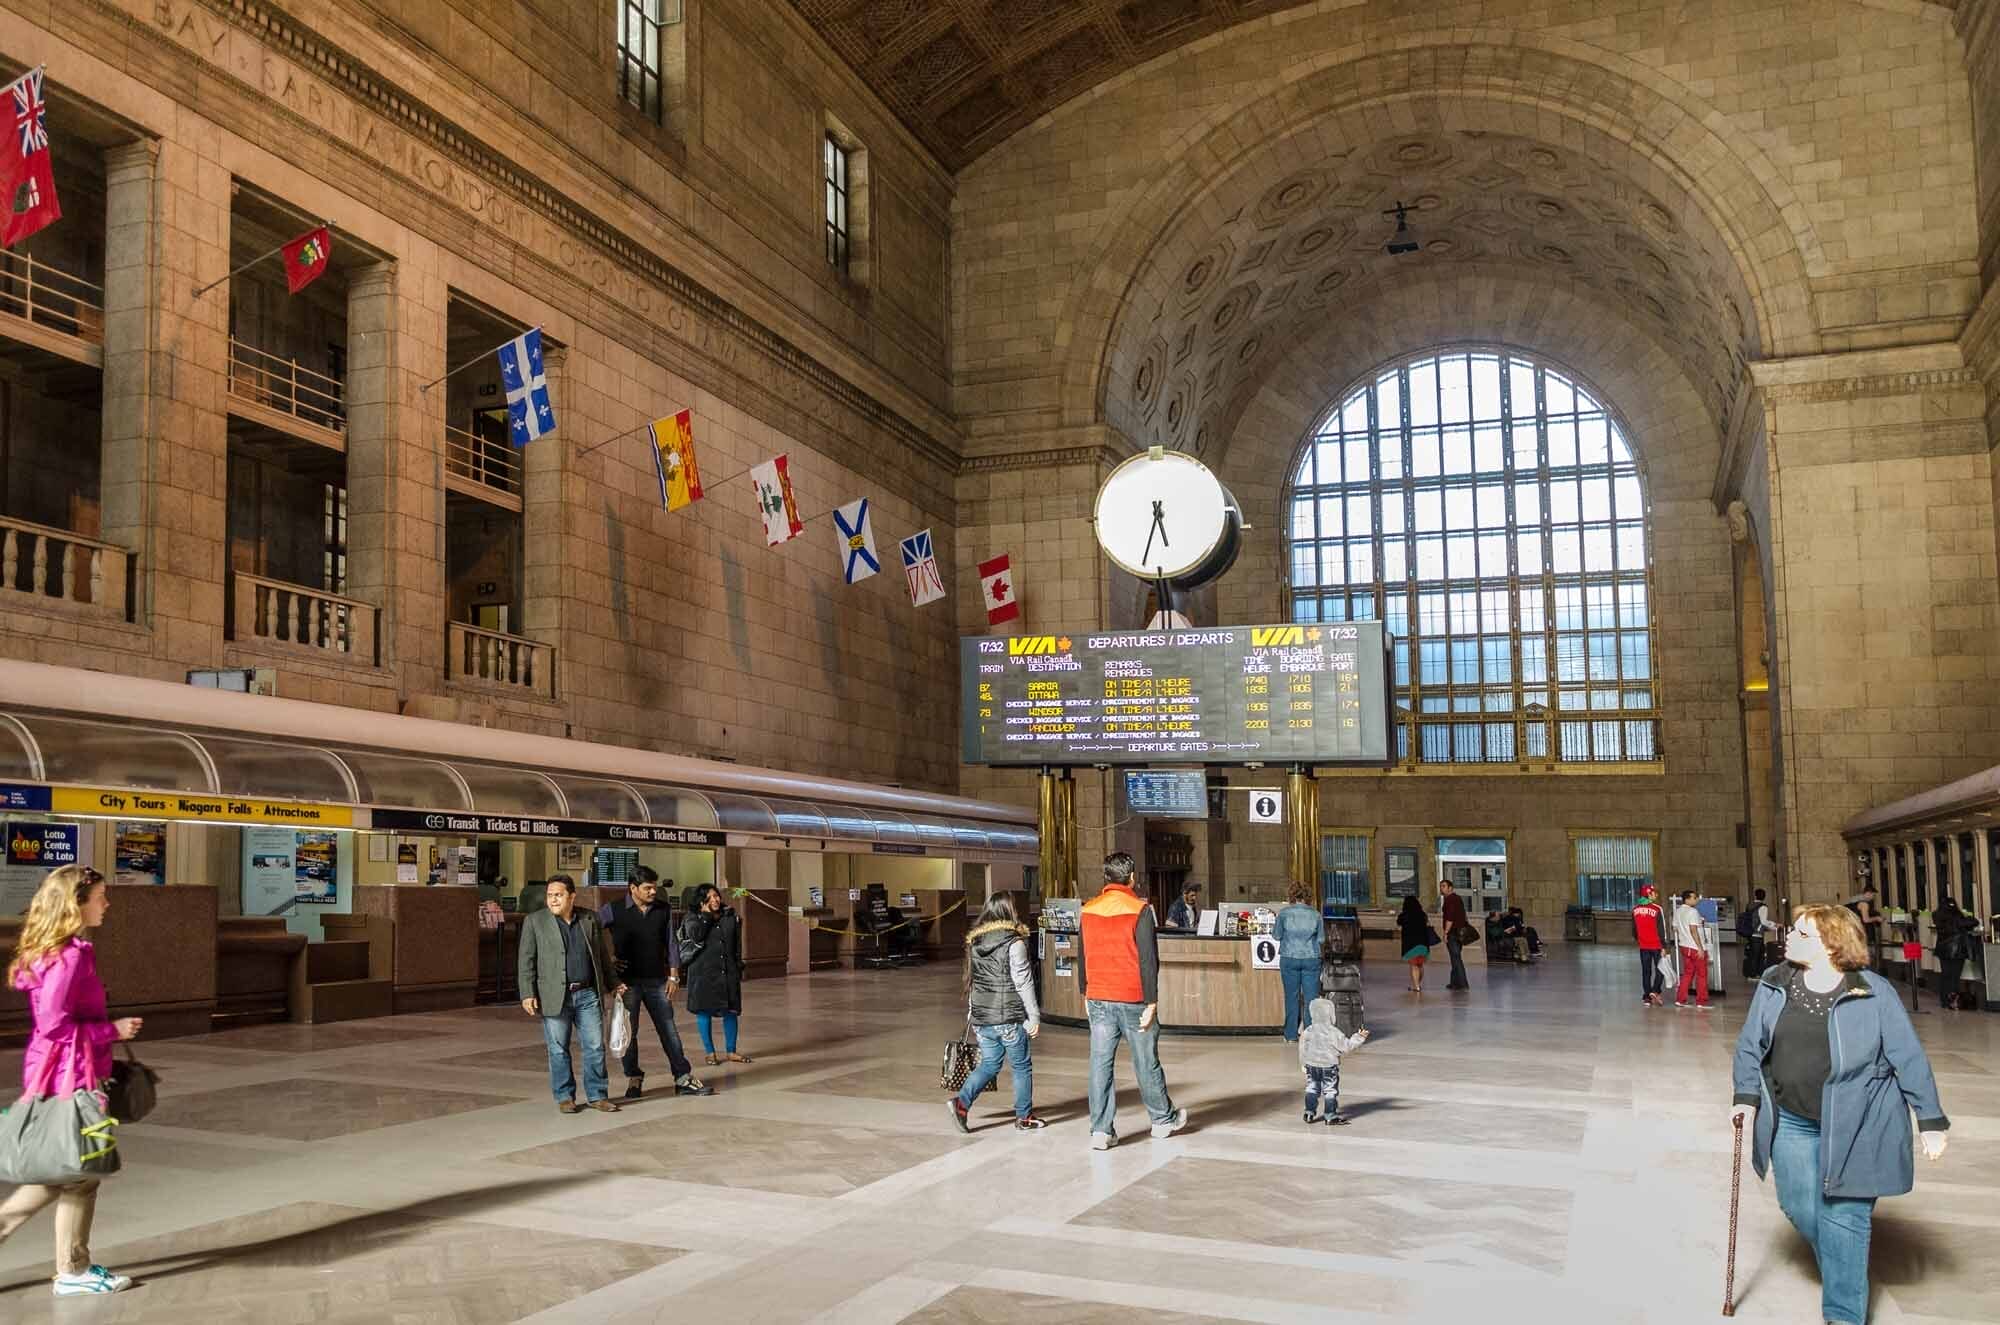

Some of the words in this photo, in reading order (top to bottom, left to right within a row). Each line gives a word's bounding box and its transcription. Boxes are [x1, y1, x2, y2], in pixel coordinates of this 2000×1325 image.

[154, 0, 226, 56] BAY
[263, 58, 382, 151] SARNIA
[1089, 636, 1165, 648] DEPARTURES
[1177, 633, 1234, 645] DEPARTS
[1251, 626, 1304, 646] VIA
[1009, 636, 1056, 655] VIA
[1253, 648, 1269, 656] VIA
[1271, 648, 1289, 656] Rail
[1010, 656, 1025, 664] VIA
[1027, 656, 1043, 664] Rail
[1243, 656, 1264, 664] TIME
[1280, 655, 1324, 663] BOARDING
[1330, 653, 1355, 662] GATE
[980, 664, 1004, 673] TRAIN
[1028, 662, 1082, 672] DESTINATION
[1104, 660, 1142, 669] REMARKS
[1243, 665, 1273, 673] HEURE
[1104, 668, 1153, 677] REMARQUES
[1027, 682, 1059, 691] SARNIA
[1105, 681, 1117, 689] ON
[1028, 691, 1060, 700] OTTAWA
[1105, 689, 1117, 698] ON
[1028, 707, 1063, 716] WINDSOR
[1105, 706, 1117, 715] ON
[1028, 723, 1076, 732] VANCOUVER
[1106, 723, 1118, 731] ON
[1128, 743, 1177, 752] DEPARTURE
[1180, 742, 1209, 751] GATES
[99, 794, 126, 810] City
[133, 796, 166, 810] Tours
[178, 800, 222, 815] Niagara
[227, 803, 252, 815] Falls
[263, 805, 320, 819] Attractions
[447, 816, 480, 831] Transit
[486, 818, 517, 832] Tickets
[533, 820, 559, 834] Billets
[44, 829, 66, 840] Lotto
[625, 827, 649, 840] Transit
[653, 829, 677, 842] Tickets
[687, 832, 707, 844] Billets
[44, 840, 71, 851] Centre
[43, 851, 54, 860] de
[56, 851, 74, 862] Loto
